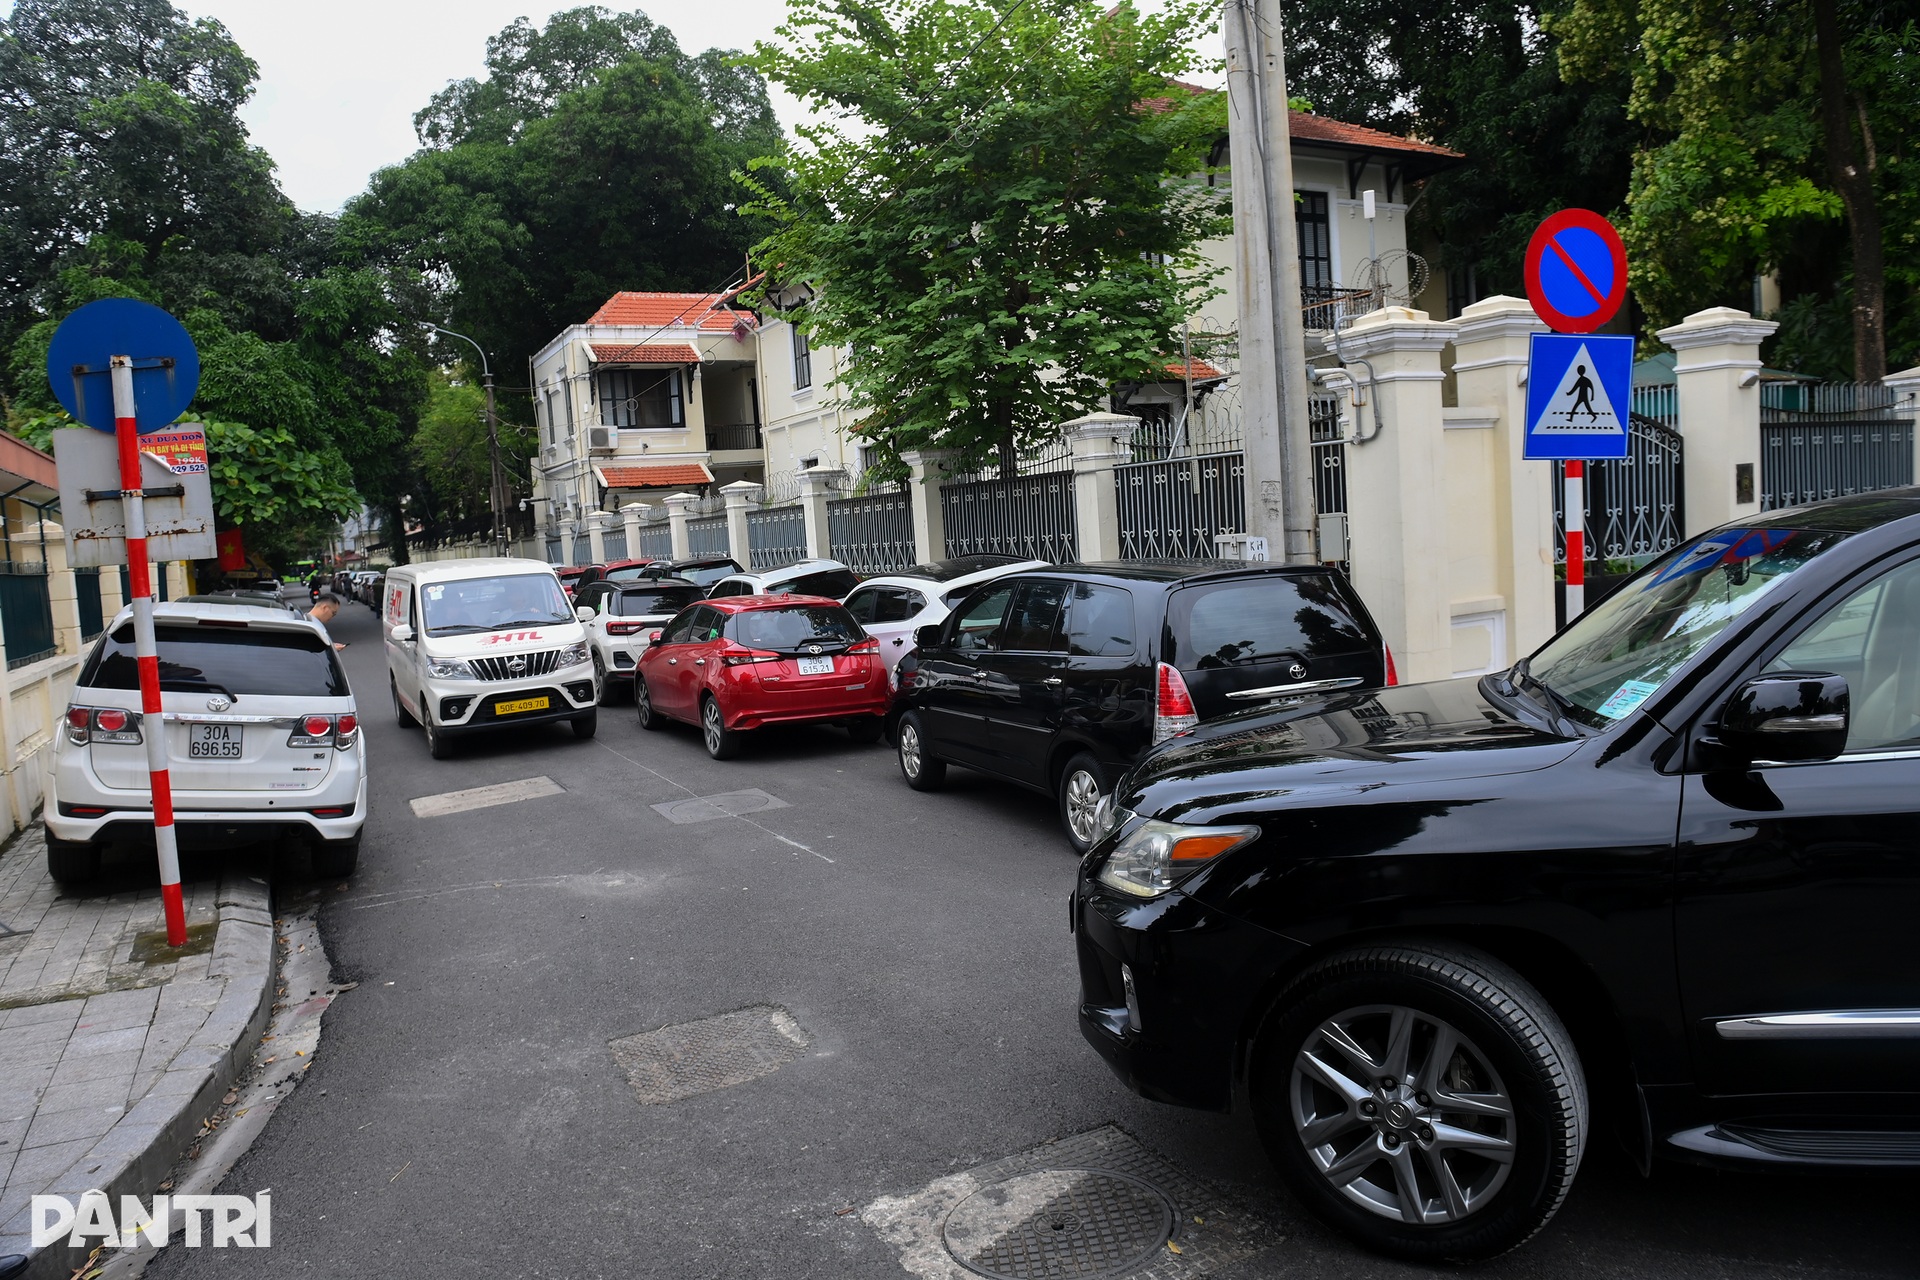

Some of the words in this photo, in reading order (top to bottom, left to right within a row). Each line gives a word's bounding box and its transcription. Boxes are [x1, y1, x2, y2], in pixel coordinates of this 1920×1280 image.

[490, 631, 543, 644] HTL
[803, 665, 830, 674] 615.21
[203, 726, 230, 740] 30A
[192, 742, 240, 756] 696.55
